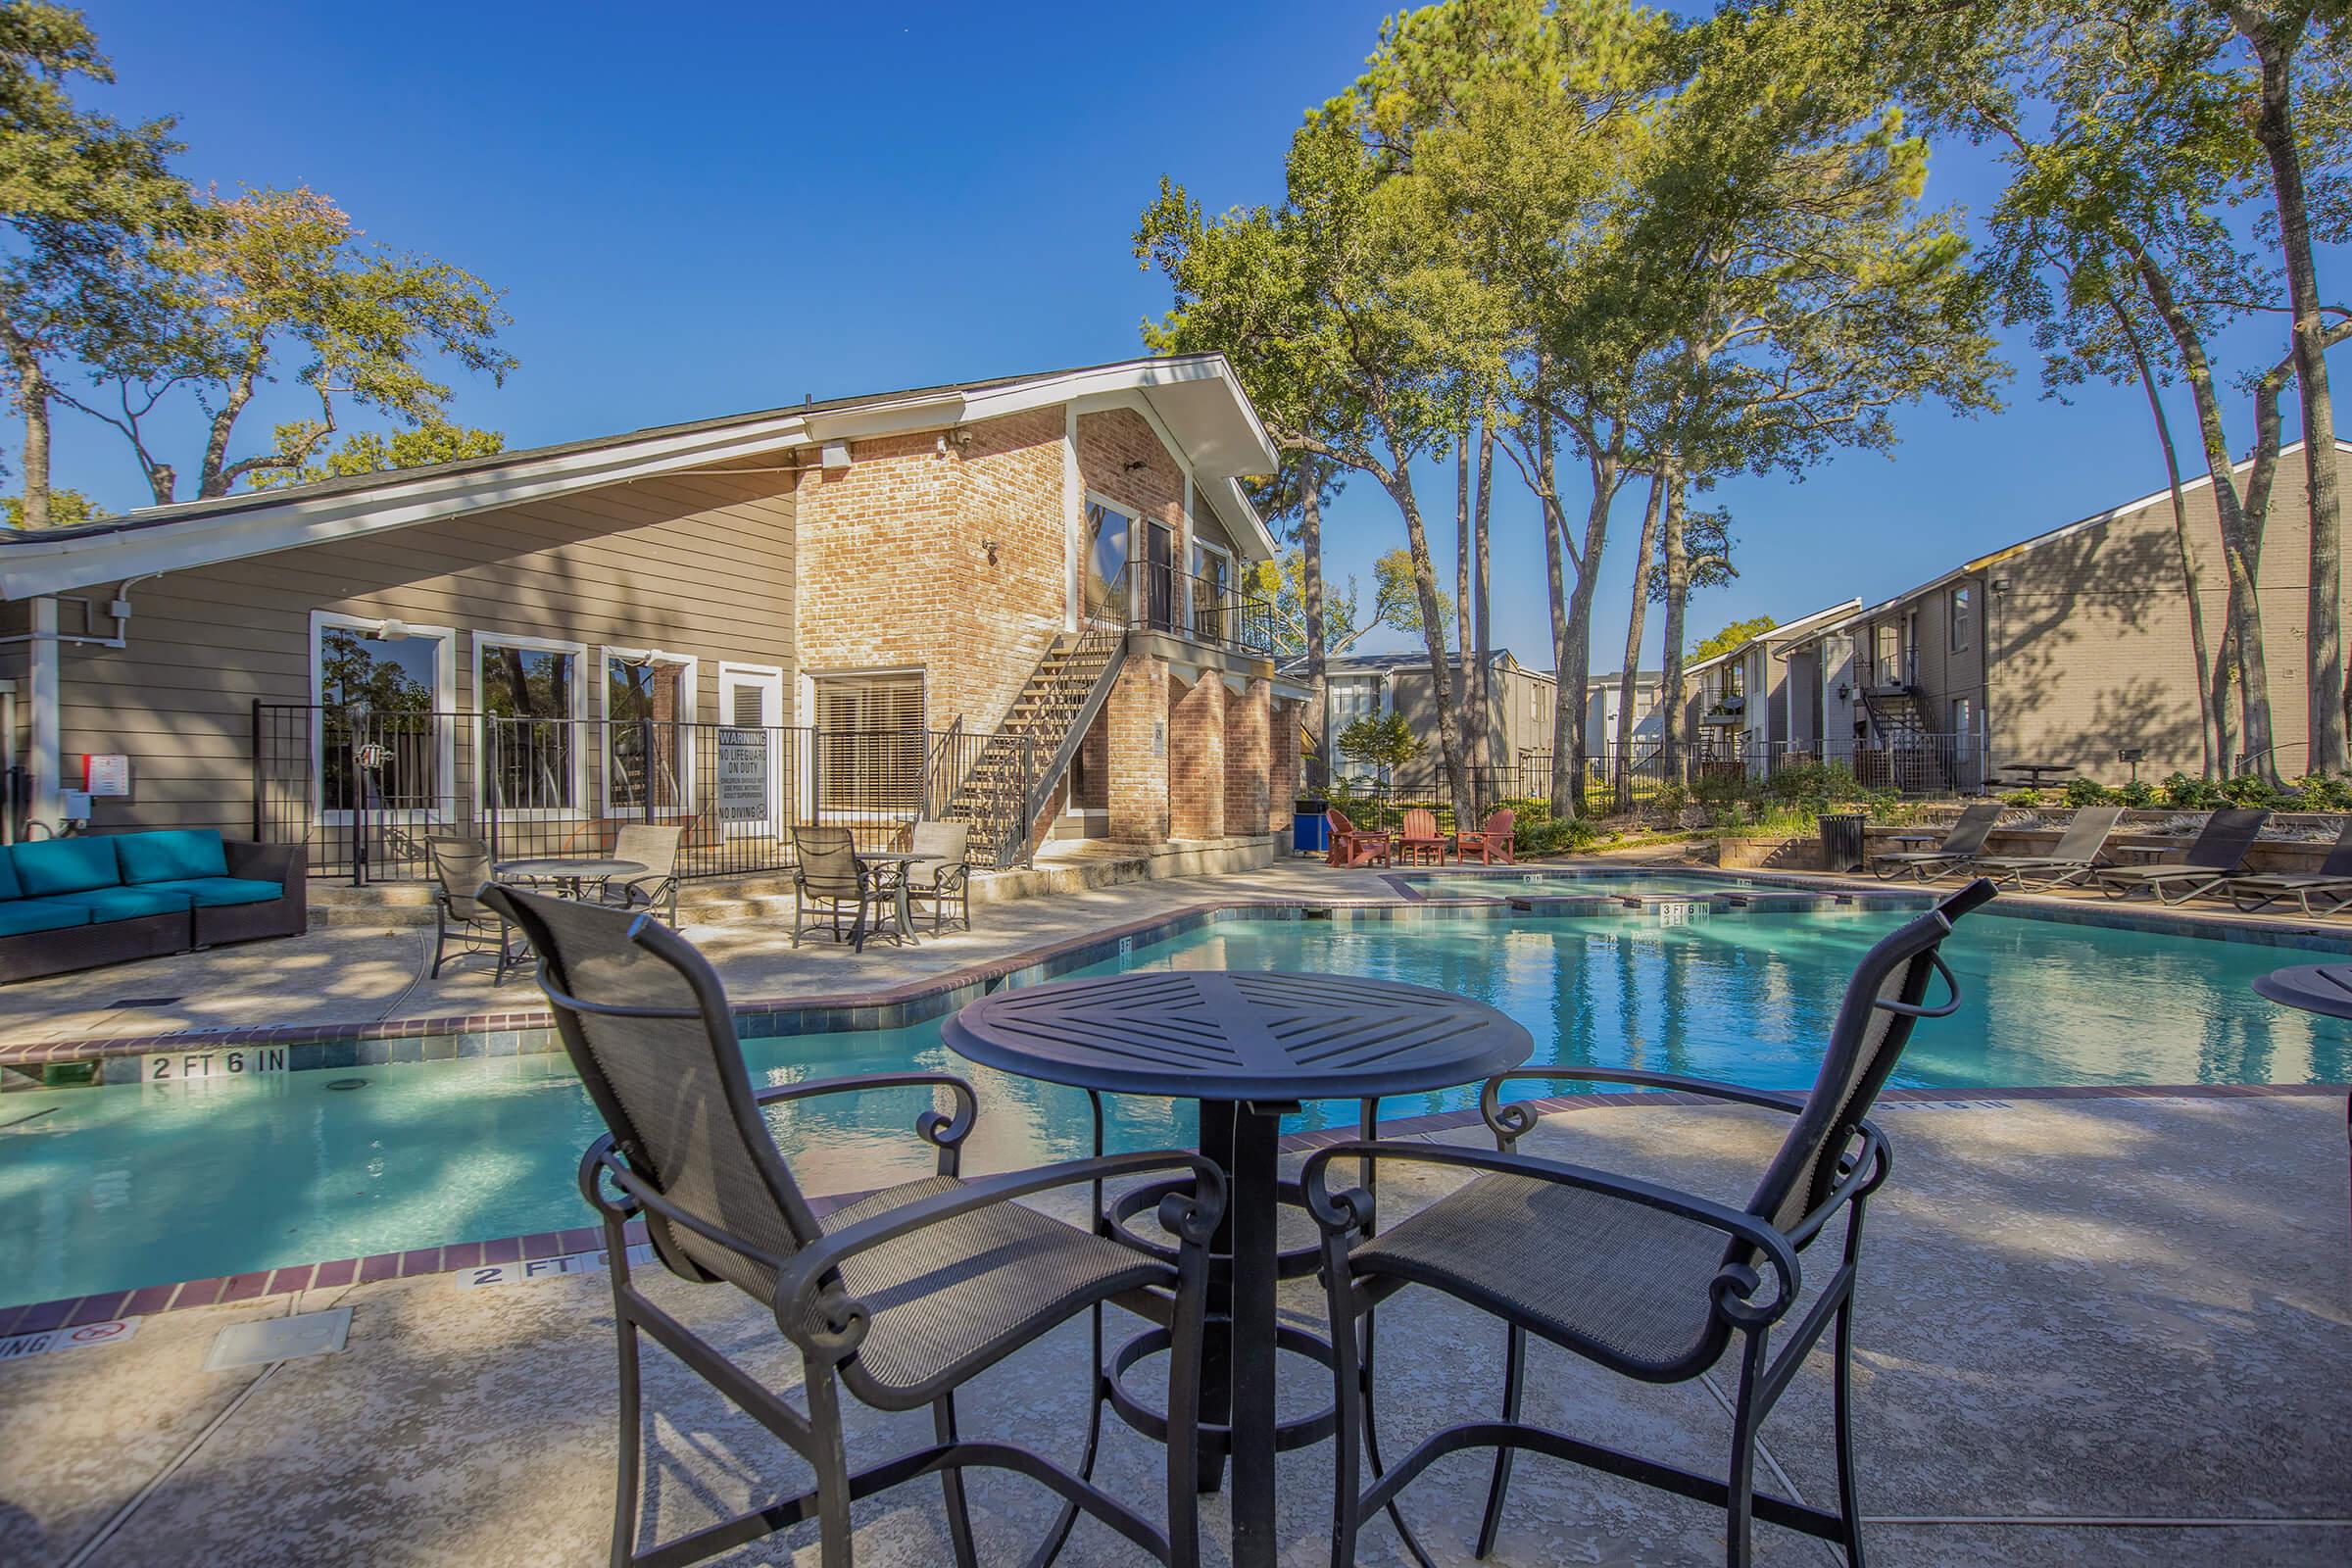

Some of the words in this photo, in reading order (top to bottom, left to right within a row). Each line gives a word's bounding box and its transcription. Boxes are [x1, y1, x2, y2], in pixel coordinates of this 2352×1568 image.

[719, 732, 766, 745] WARNING
[719, 749, 729, 760] NO
[731, 749, 766, 760] LIFEGUARD
[728, 761, 738, 773] ON
[740, 761, 758, 773] DUTY
[719, 807, 729, 818] NO
[731, 807, 755, 818] DIVING
[1663, 905, 1670, 914] 3
[1674, 905, 1685, 914] FT
[1689, 905, 1694, 914] 6
[1698, 904, 1708, 914] IN
[1121, 940, 1125, 954] 3
[153, 1057, 171, 1079] 2
[184, 1054, 214, 1077] FT
[227, 1052, 244, 1073] 6
[259, 1049, 283, 1072] IN
[473, 1268, 503, 1286] 2
[525, 1256, 575, 1277] FT
